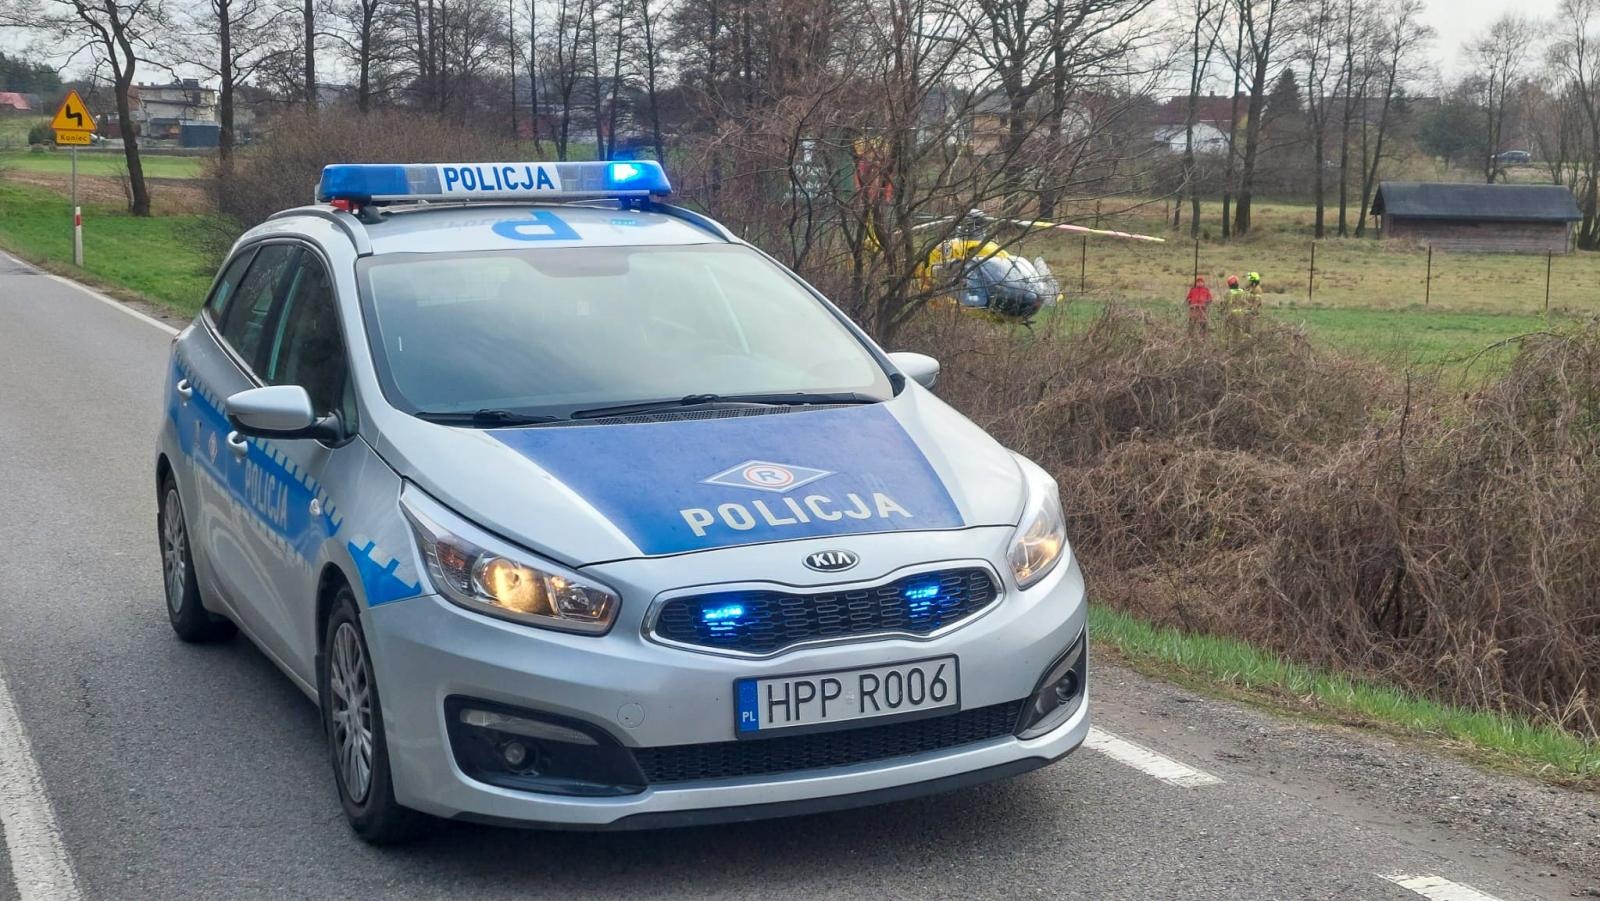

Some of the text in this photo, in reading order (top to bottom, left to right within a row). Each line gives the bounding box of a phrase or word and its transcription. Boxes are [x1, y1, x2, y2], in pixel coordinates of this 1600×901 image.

[443, 166, 555, 191] POLICJA
[758, 470, 779, 481] R
[244, 458, 288, 531] POLICJA
[679, 492, 913, 537] POLICJA
[812, 552, 850, 566] KIA
[742, 664, 948, 723] PL HPP R006
